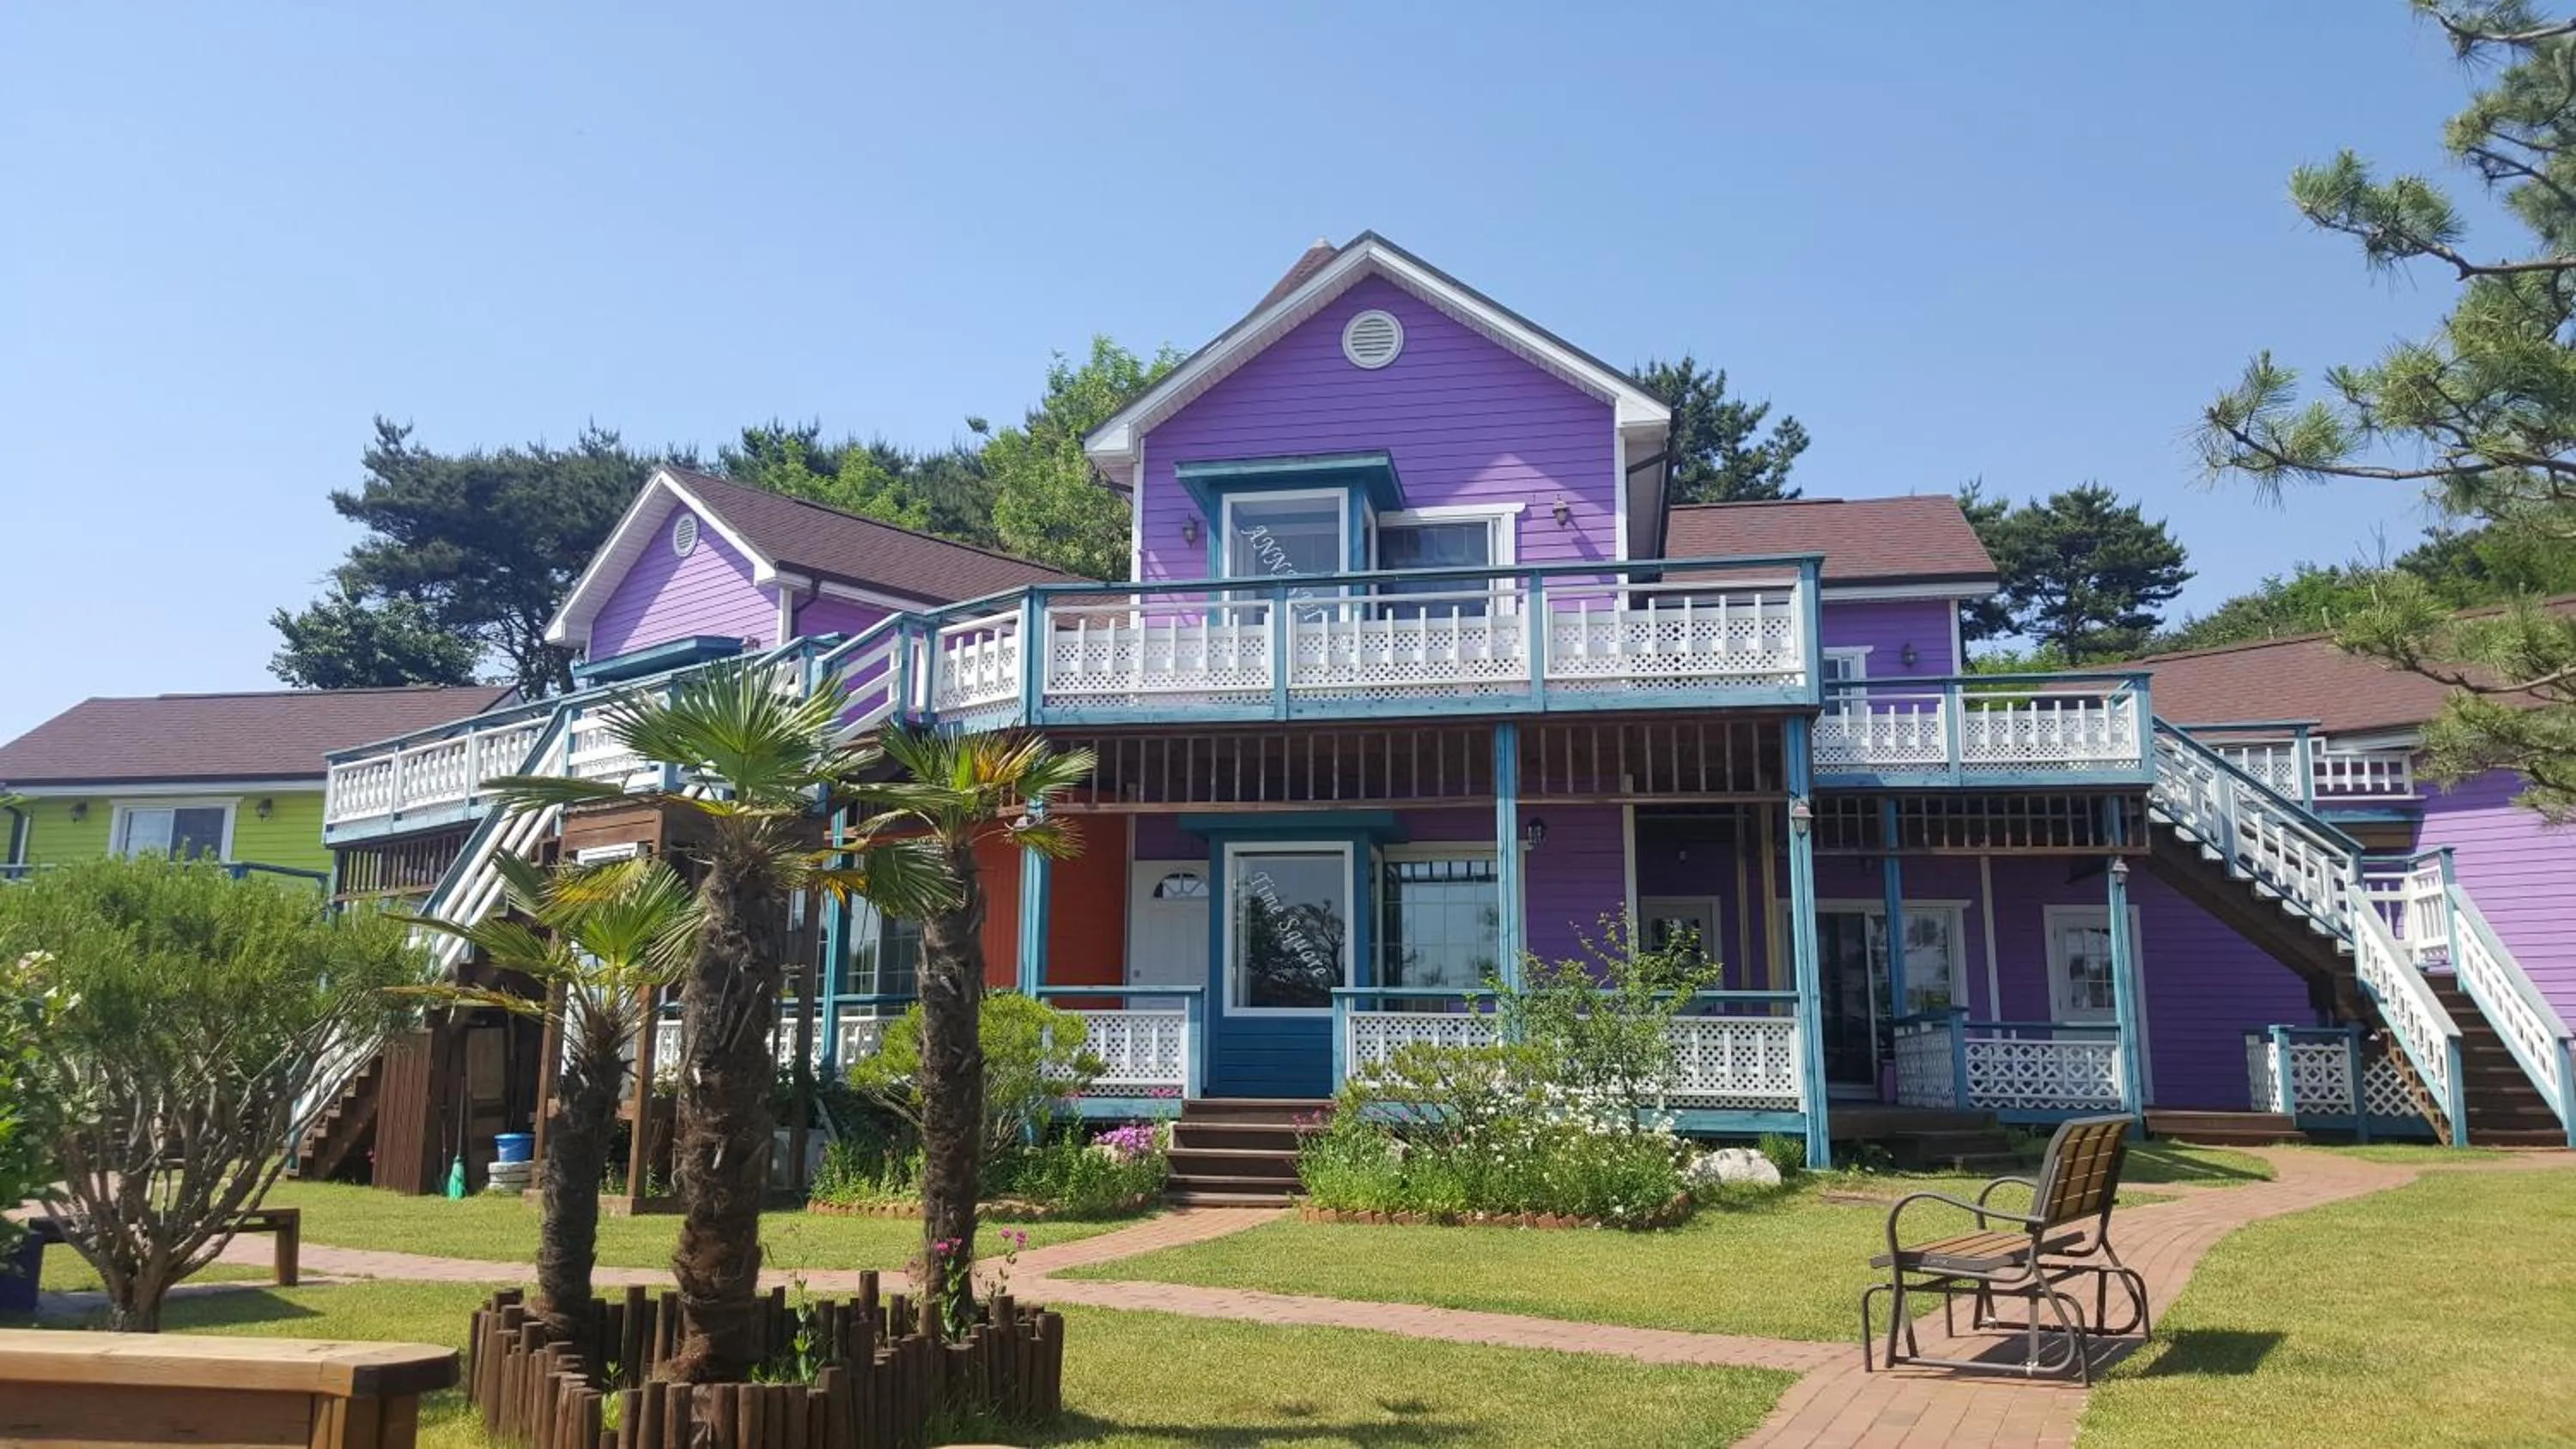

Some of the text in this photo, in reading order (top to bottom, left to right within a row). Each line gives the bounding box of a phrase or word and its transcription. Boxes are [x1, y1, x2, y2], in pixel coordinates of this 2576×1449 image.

[1241, 524, 1297, 578] ANN
[1250, 871, 1327, 978] Time Square
